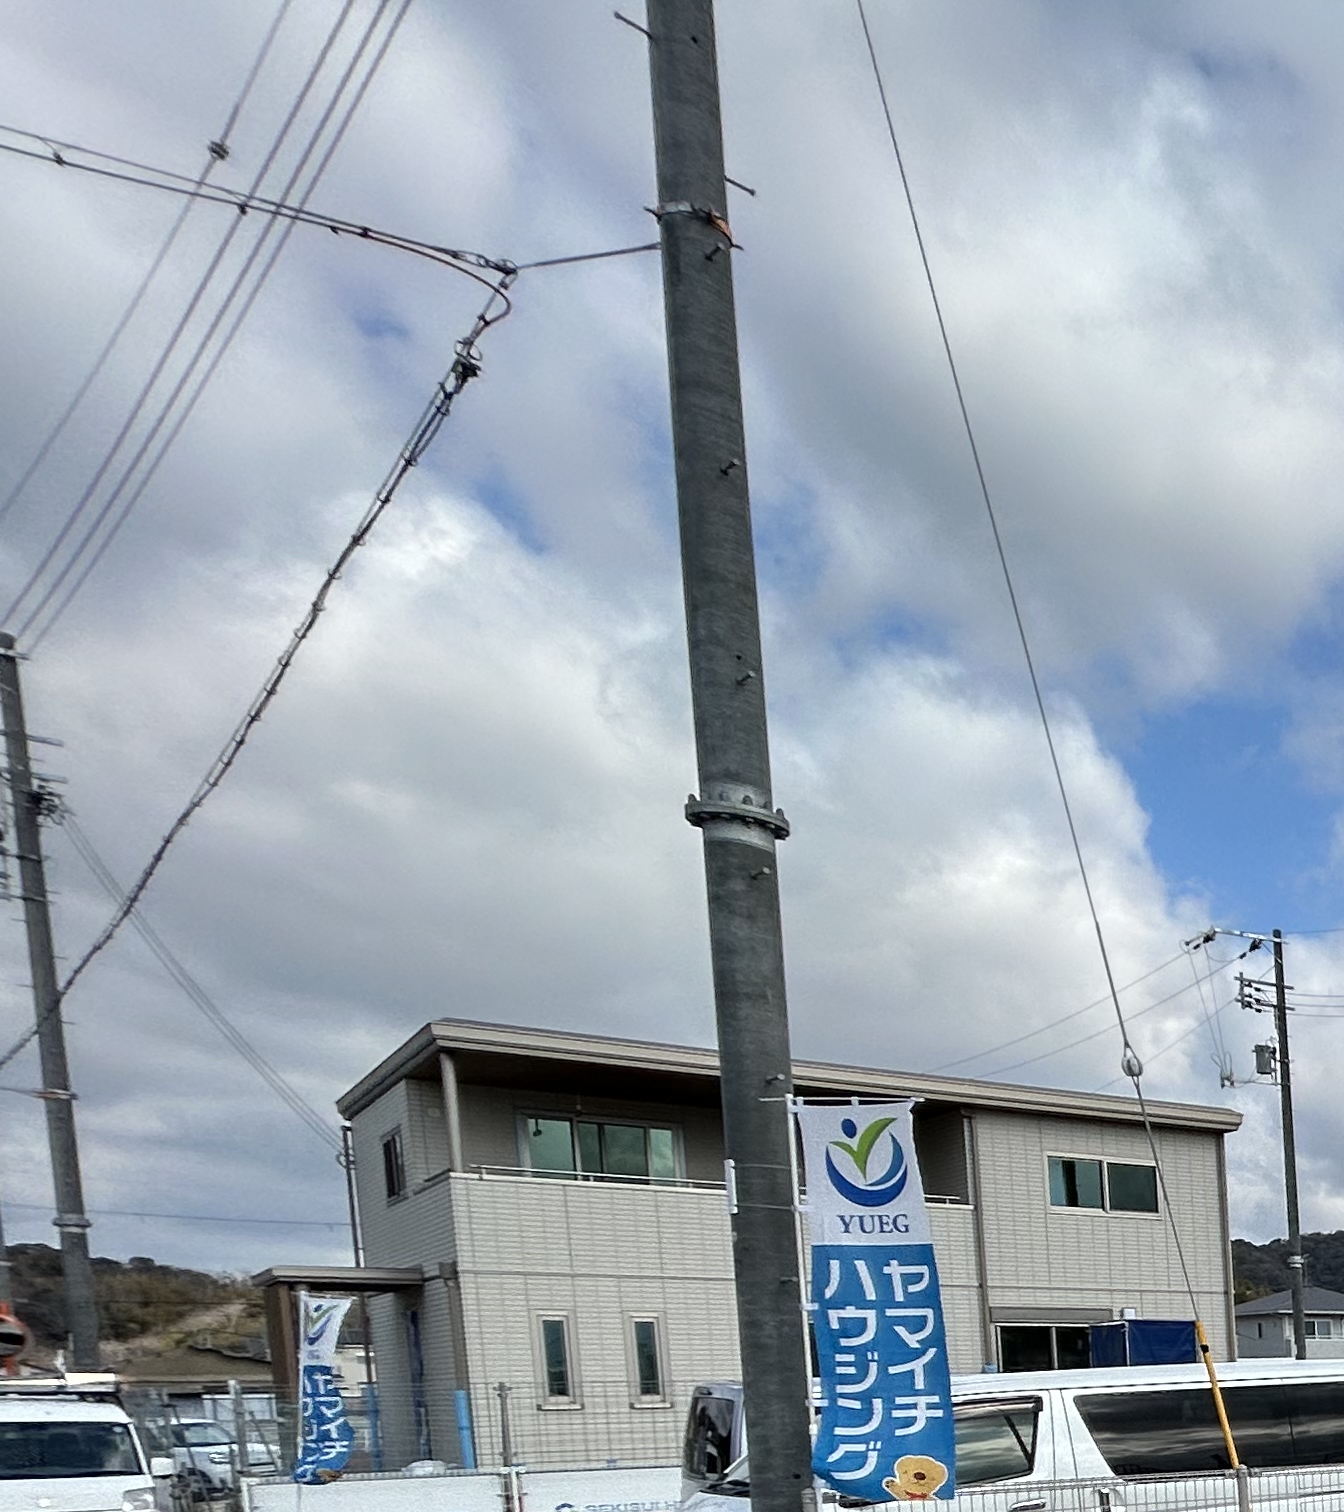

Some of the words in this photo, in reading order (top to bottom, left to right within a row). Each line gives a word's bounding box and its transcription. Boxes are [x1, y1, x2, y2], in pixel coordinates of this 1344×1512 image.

[837, 1213, 910, 1234] YUEG
[824, 1259, 883, 1481] ハウジング
[883, 1259, 944, 1437] ヤマイチ
